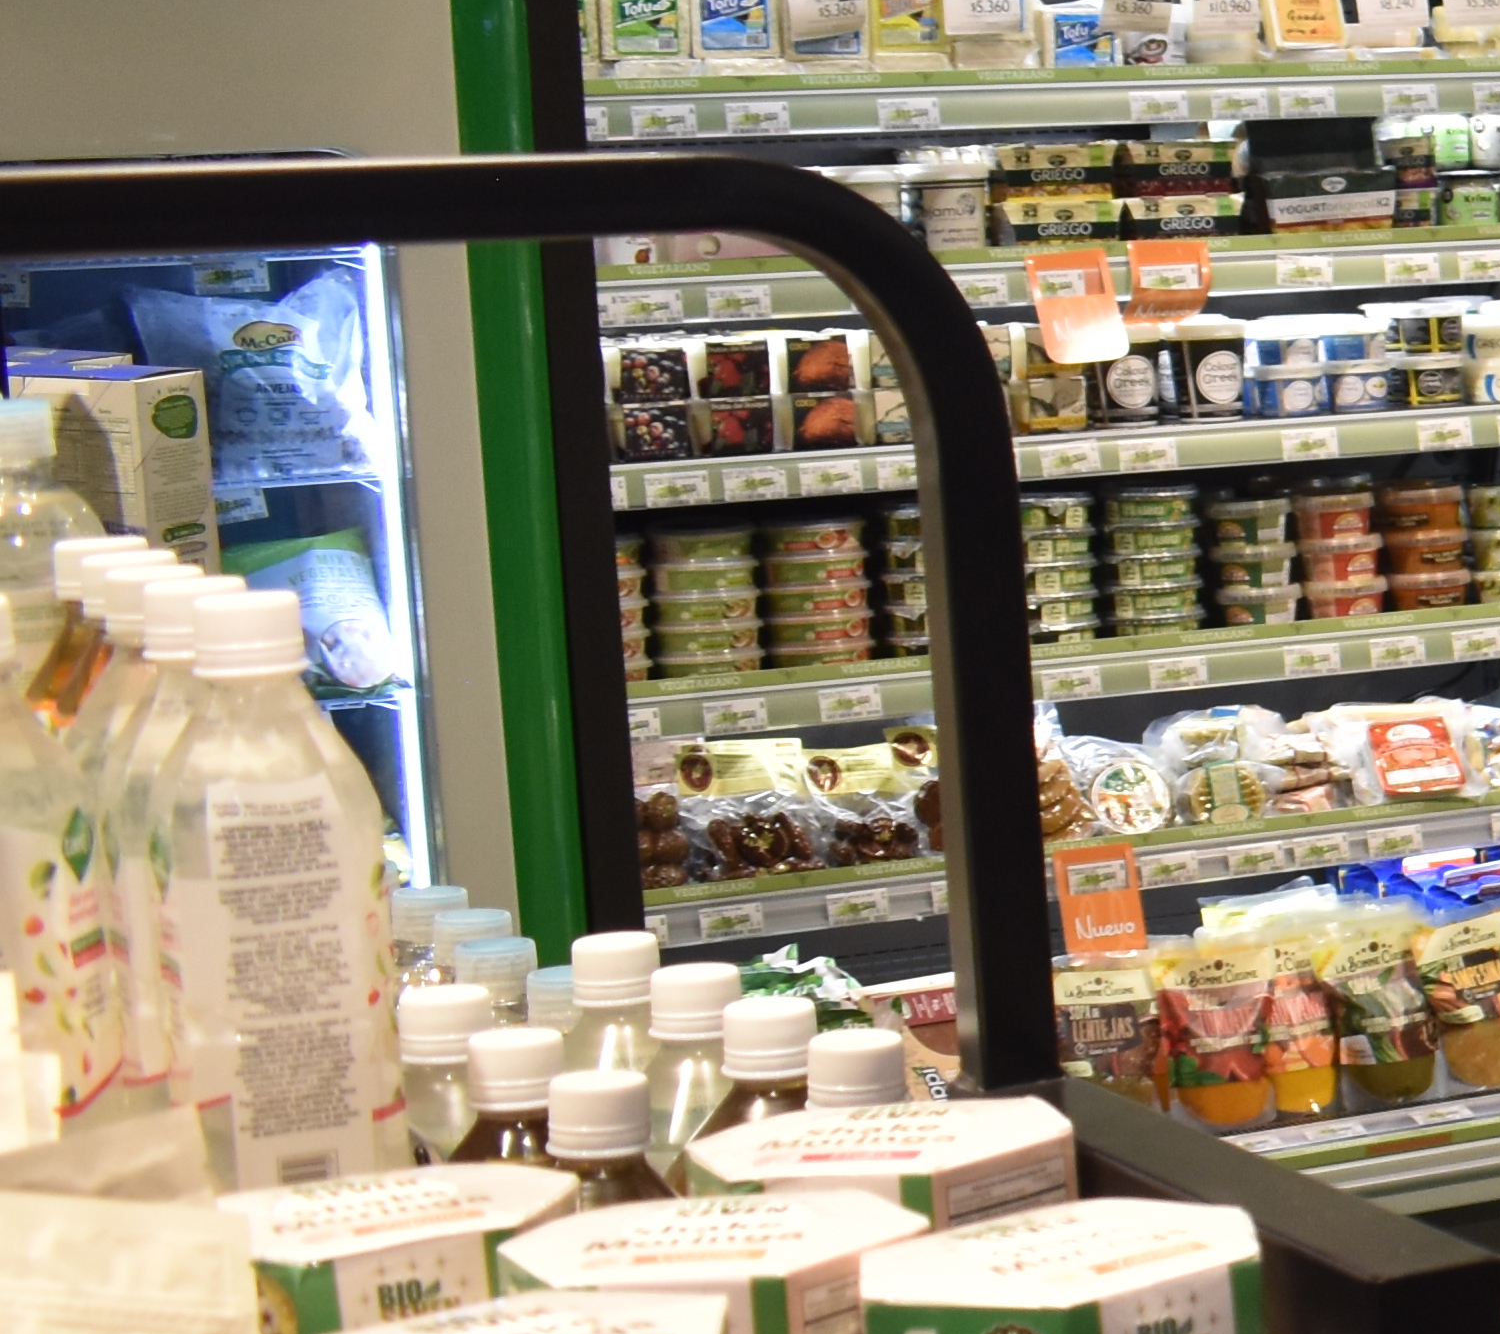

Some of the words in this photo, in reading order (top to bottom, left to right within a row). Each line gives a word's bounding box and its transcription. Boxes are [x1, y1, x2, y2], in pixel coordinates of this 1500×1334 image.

[1059, 21, 1090, 43] Tofu
[1031, 168, 1086, 184] GRIEGO
[1278, 200, 1329, 218] YOGURT
[1035, 219, 1093, 238] GRIEGO
[1160, 213, 1215, 233] GRIEGO
[1075, 916, 1136, 940] Nuevo
